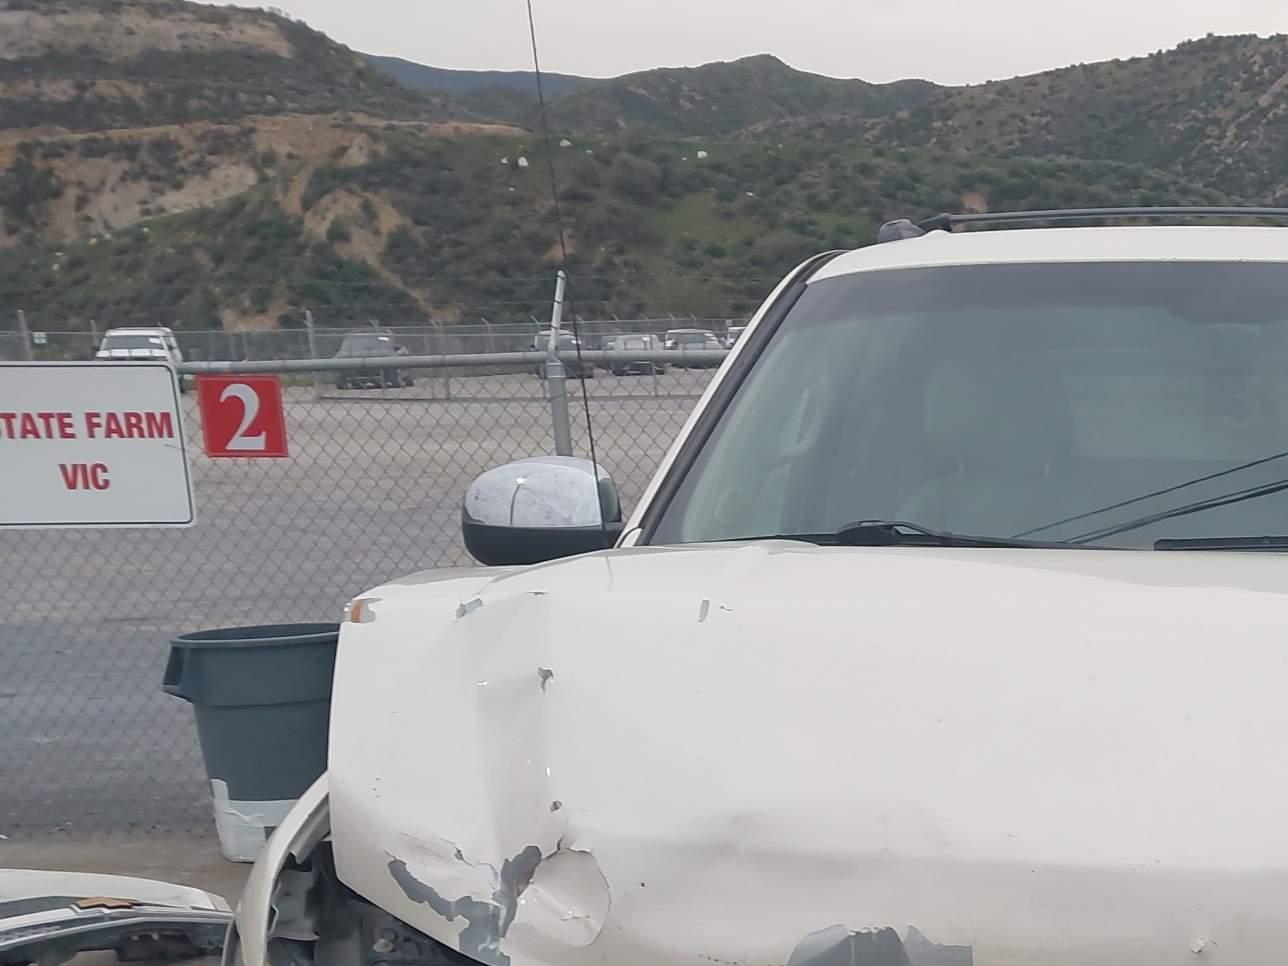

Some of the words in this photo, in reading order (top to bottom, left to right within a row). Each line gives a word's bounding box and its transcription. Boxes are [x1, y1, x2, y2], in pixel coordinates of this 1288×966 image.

[0, 412, 77, 439] TATE
[84, 411, 175, 439] FARM
[219, 383, 267, 450] 2
[58, 462, 110, 490] VIC
